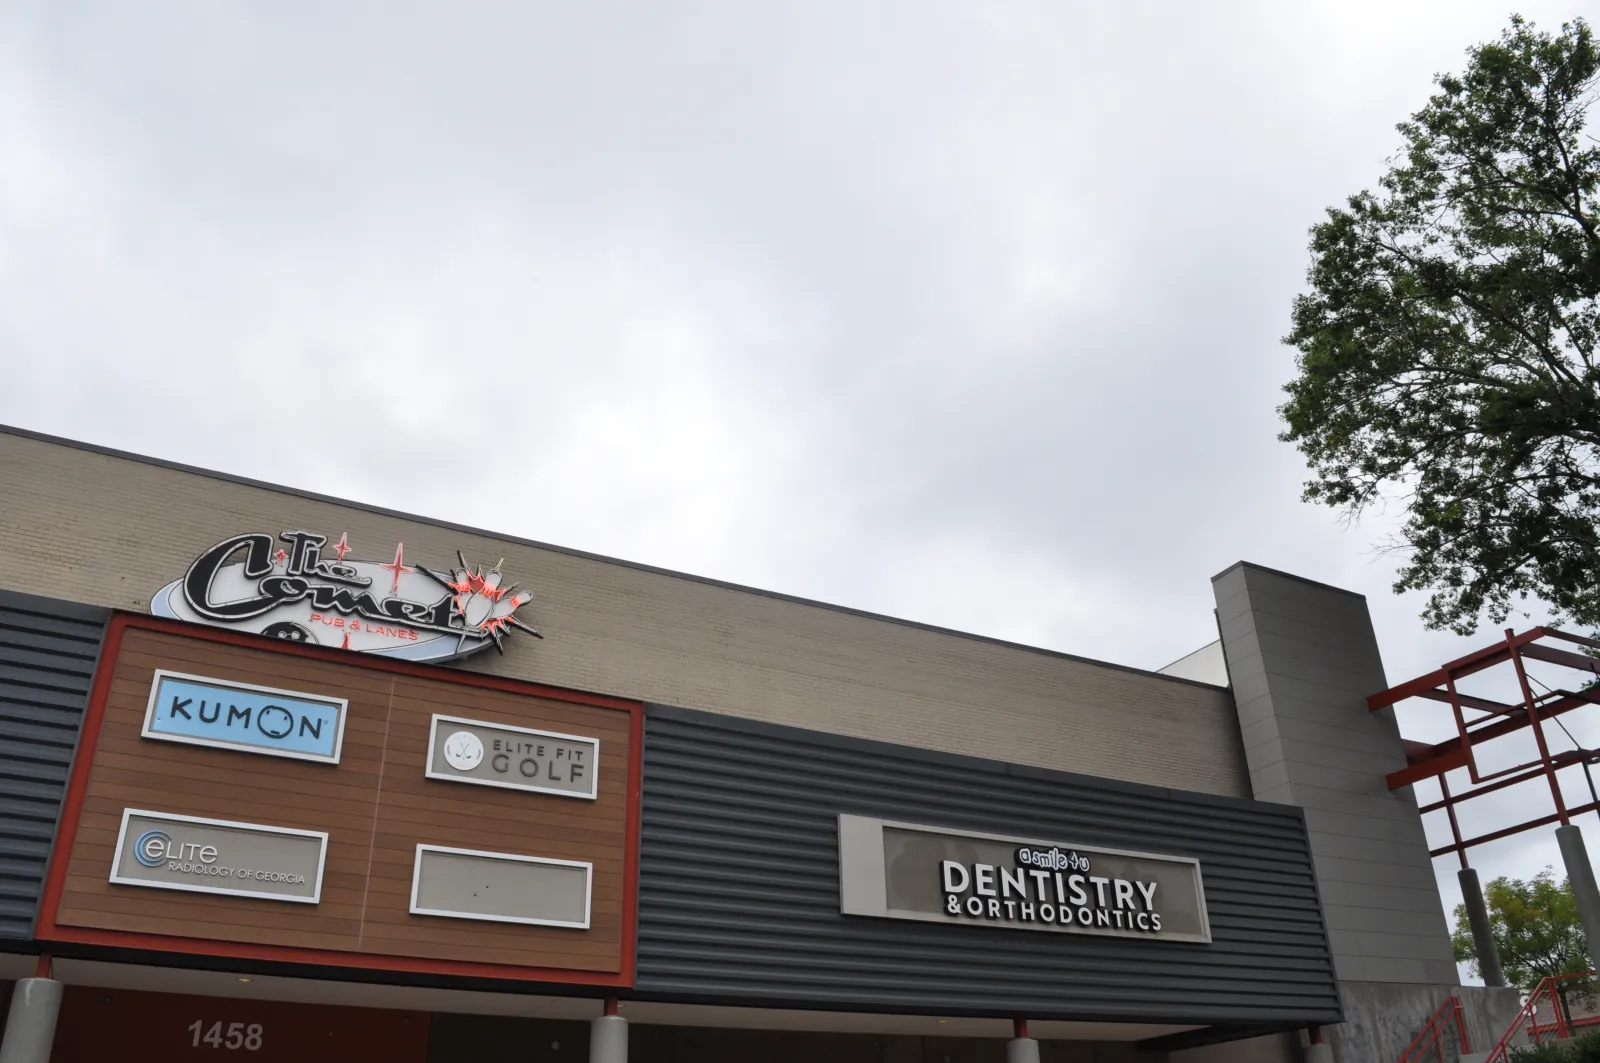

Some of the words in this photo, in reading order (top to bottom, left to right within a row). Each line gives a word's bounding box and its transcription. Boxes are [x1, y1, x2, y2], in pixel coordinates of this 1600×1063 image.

[278, 529, 372, 587] The
[183, 532, 490, 638] Comet
[310, 612, 345, 627] PUB
[350, 619, 362, 631] &
[366, 622, 419, 641] LANES
[170, 696, 322, 739] KUMON
[493, 739, 545, 757] ELITE
[556, 747, 584, 762] FIT
[492, 753, 584, 782] GOLF
[168, 861, 235, 877] RADIOLOGY
[237, 868, 253, 880] OF
[255, 870, 305, 884] GEORGIA
[1019, 847, 1031, 864] a
[1032, 847, 1067, 871] smile
[1068, 850, 1079, 869] 4
[942, 860, 1157, 911] DENTISTRY
[187, 1019, 264, 1051] 1458
